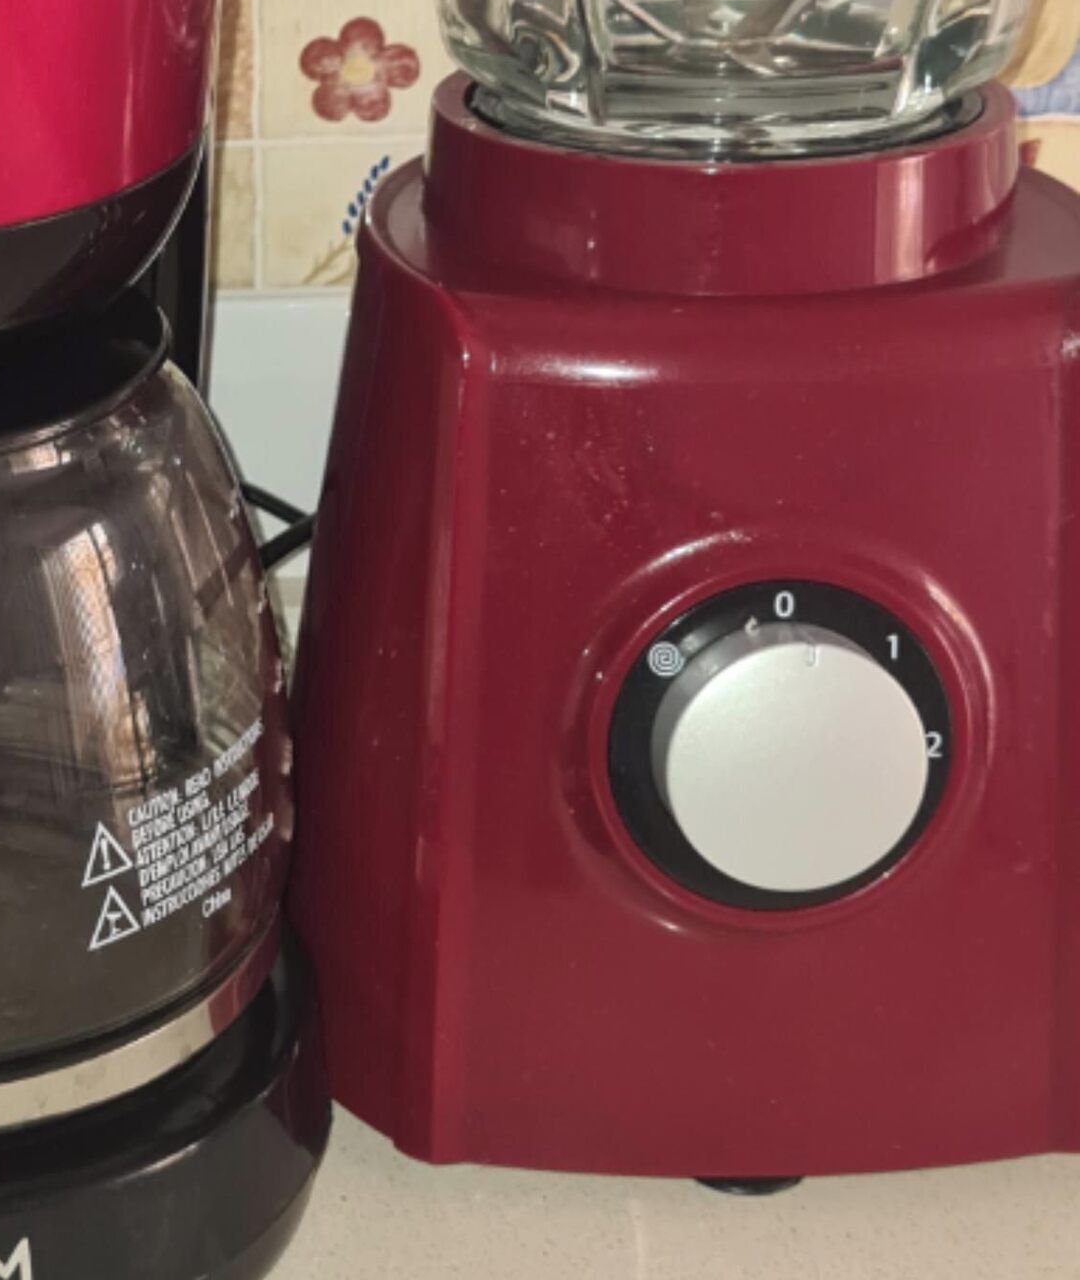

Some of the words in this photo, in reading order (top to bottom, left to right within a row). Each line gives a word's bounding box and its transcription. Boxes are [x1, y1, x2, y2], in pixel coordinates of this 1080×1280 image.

[774, 590, 795, 618] 0
[885, 633, 900, 661] 1
[924, 730, 943, 758] 2
